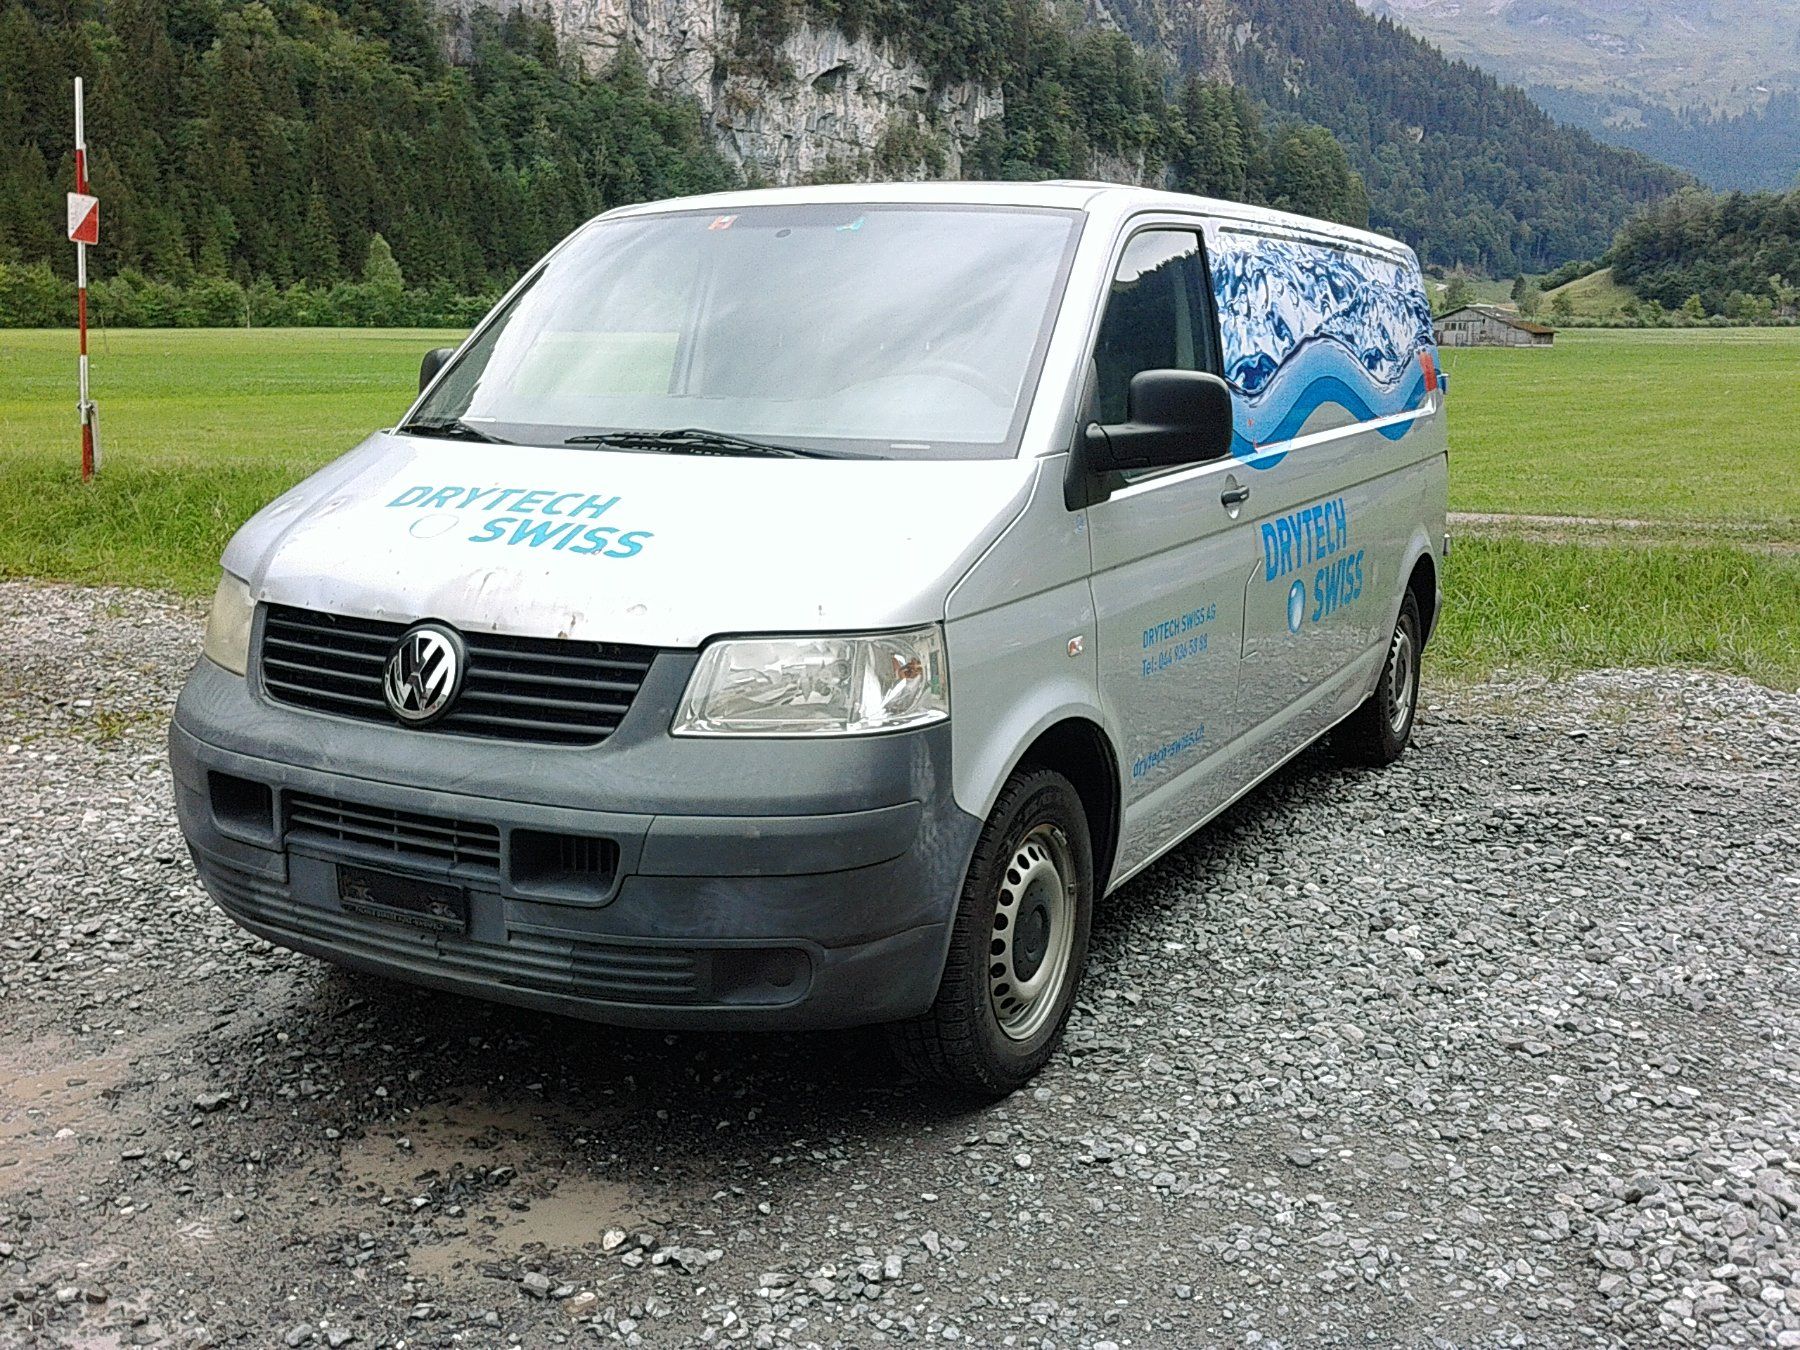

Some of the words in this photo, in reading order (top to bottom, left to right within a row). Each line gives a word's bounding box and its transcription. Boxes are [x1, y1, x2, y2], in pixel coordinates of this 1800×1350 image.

[385, 486, 622, 518] DRYTECH
[468, 517, 655, 559] SWISS
[1261, 498, 1346, 582] DRYTECH
[1312, 549, 1364, 622] SWISS
[1143, 618, 1180, 649] DRYTECH
[1181, 607, 1204, 633] SWISS
[1206, 602, 1216, 621] AG
[1142, 656, 1157, 677] Tel:
